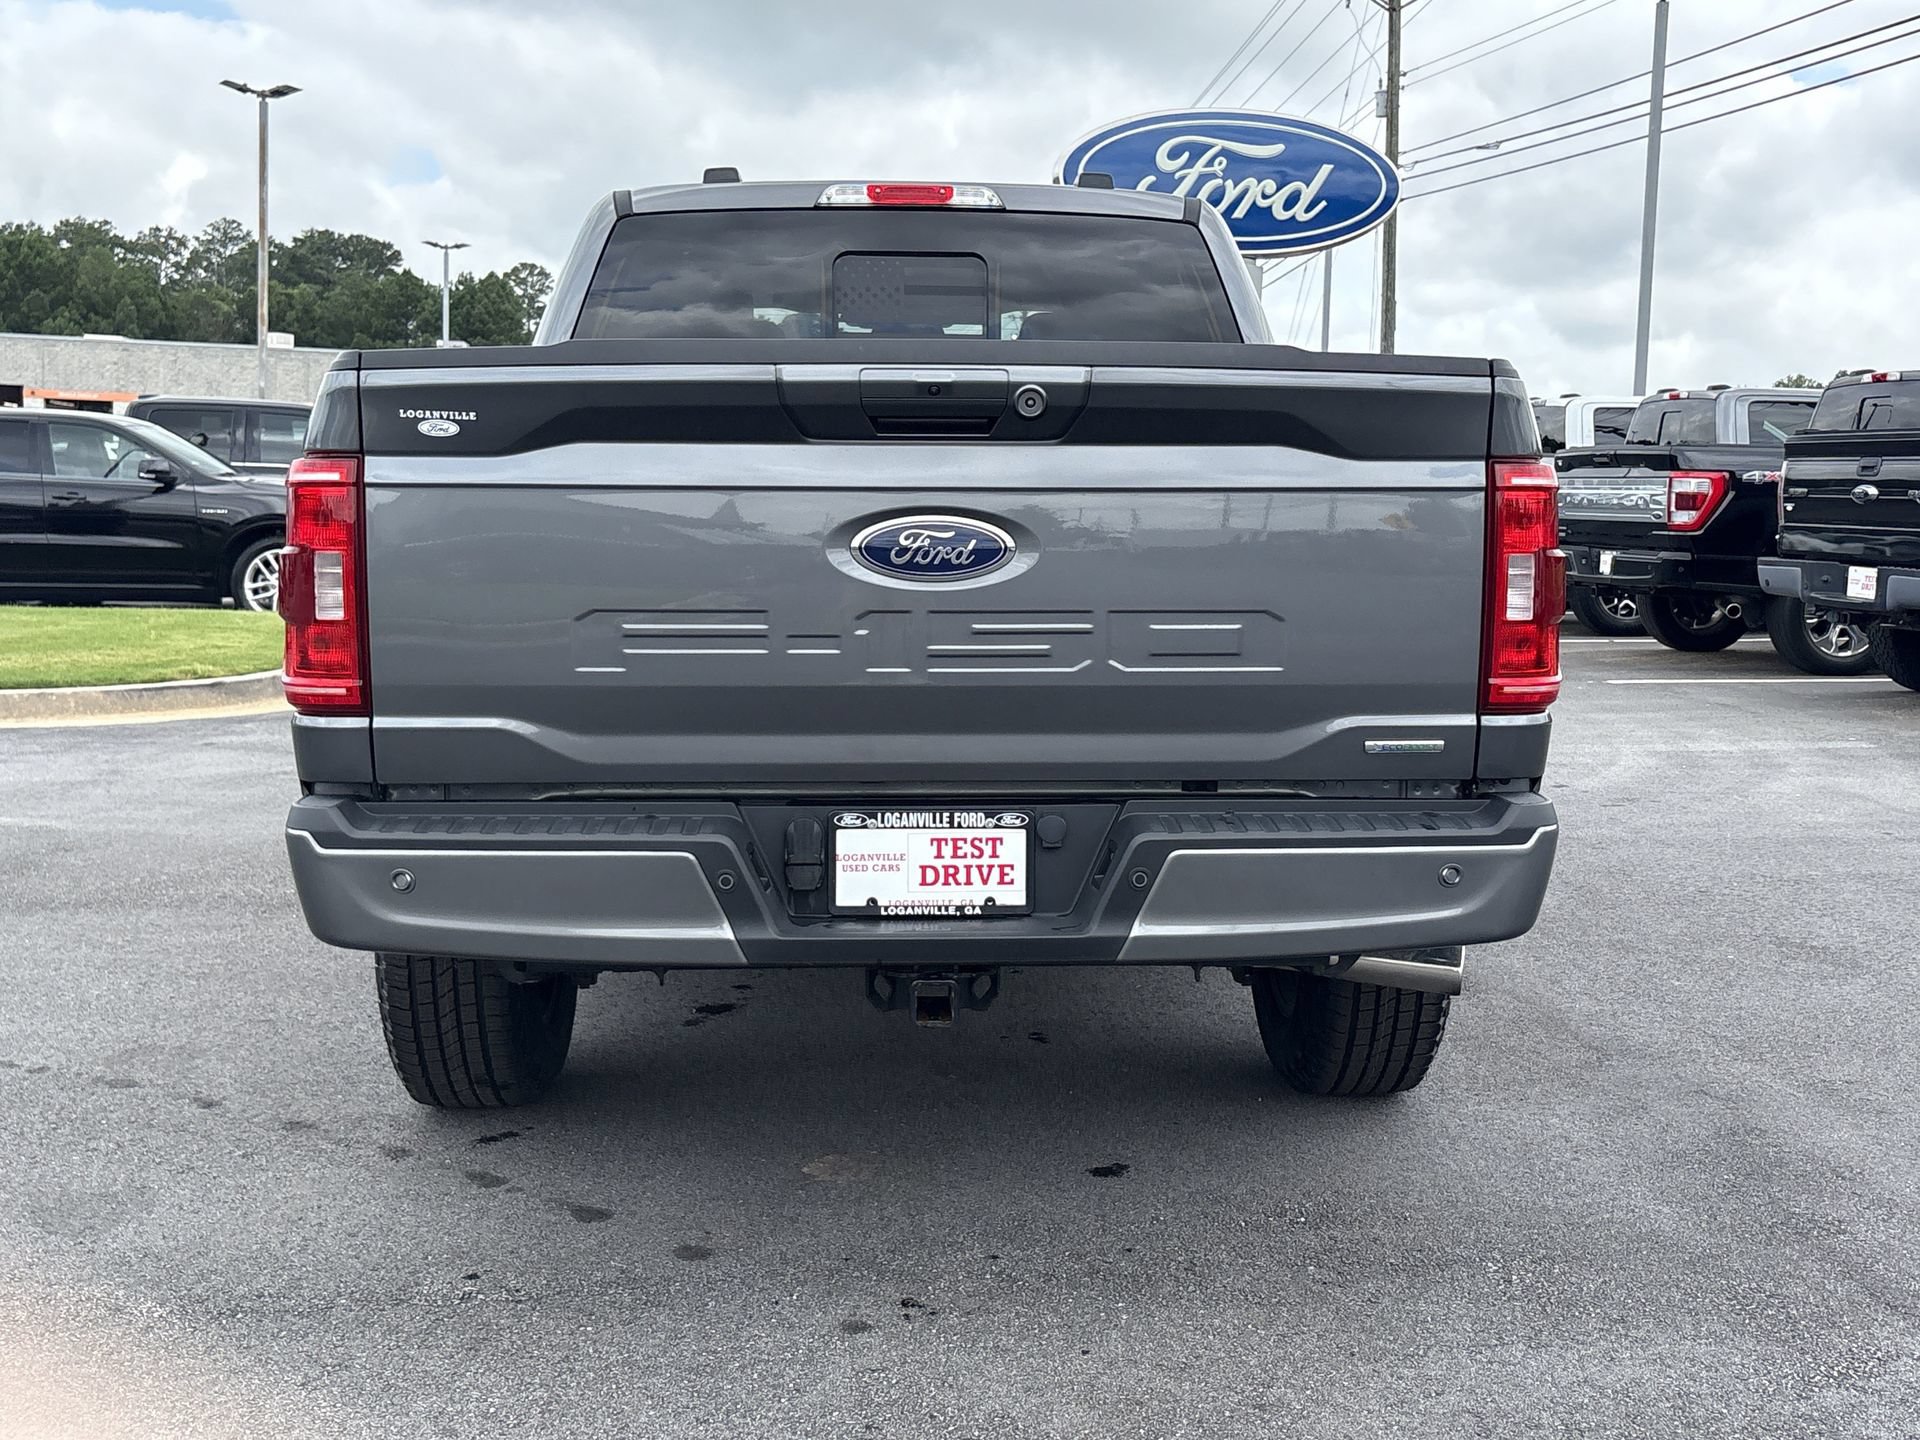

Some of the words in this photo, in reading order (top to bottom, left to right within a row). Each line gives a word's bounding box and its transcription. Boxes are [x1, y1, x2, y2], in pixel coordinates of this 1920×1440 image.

[1136, 135, 1335, 221] Ford
[399, 408, 477, 420] LOGANVILLE
[426, 423, 450, 433] Ford
[890, 529, 977, 565] Ford
[840, 815, 862, 825] Ford
[877, 812, 950, 828] LOGANVILLE
[953, 812, 986, 828] FORD
[1000, 815, 1022, 825] Ford
[930, 837, 1004, 860] TEST
[835, 853, 907, 862] LOGANVILLE
[842, 864, 869, 872] USED
[872, 864, 901, 872] CARS
[919, 864, 1015, 887] DRIVE
[880, 906, 960, 917] LOGANVILLE,
[964, 906, 982, 915] GA
